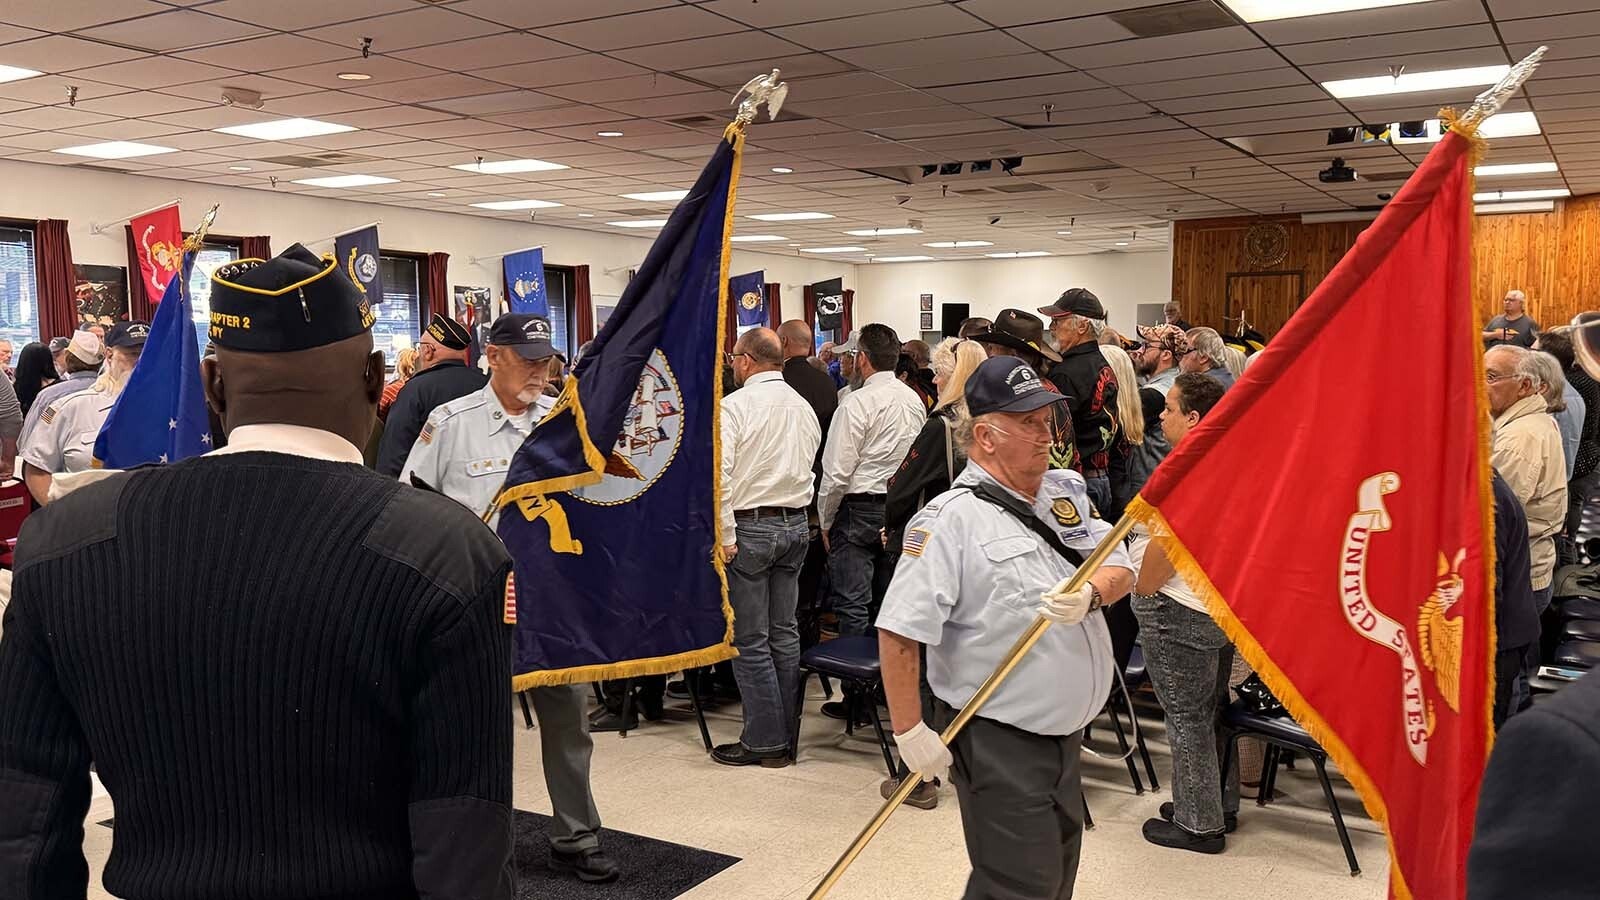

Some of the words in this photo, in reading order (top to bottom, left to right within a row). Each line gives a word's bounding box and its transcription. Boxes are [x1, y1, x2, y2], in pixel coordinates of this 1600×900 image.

[242, 316, 251, 329] 2
[536, 322, 544, 332] 6
[1021, 369, 1031, 381] 6
[1344, 526, 1378, 633] UNITED
[1391, 627, 1429, 746] STATES
